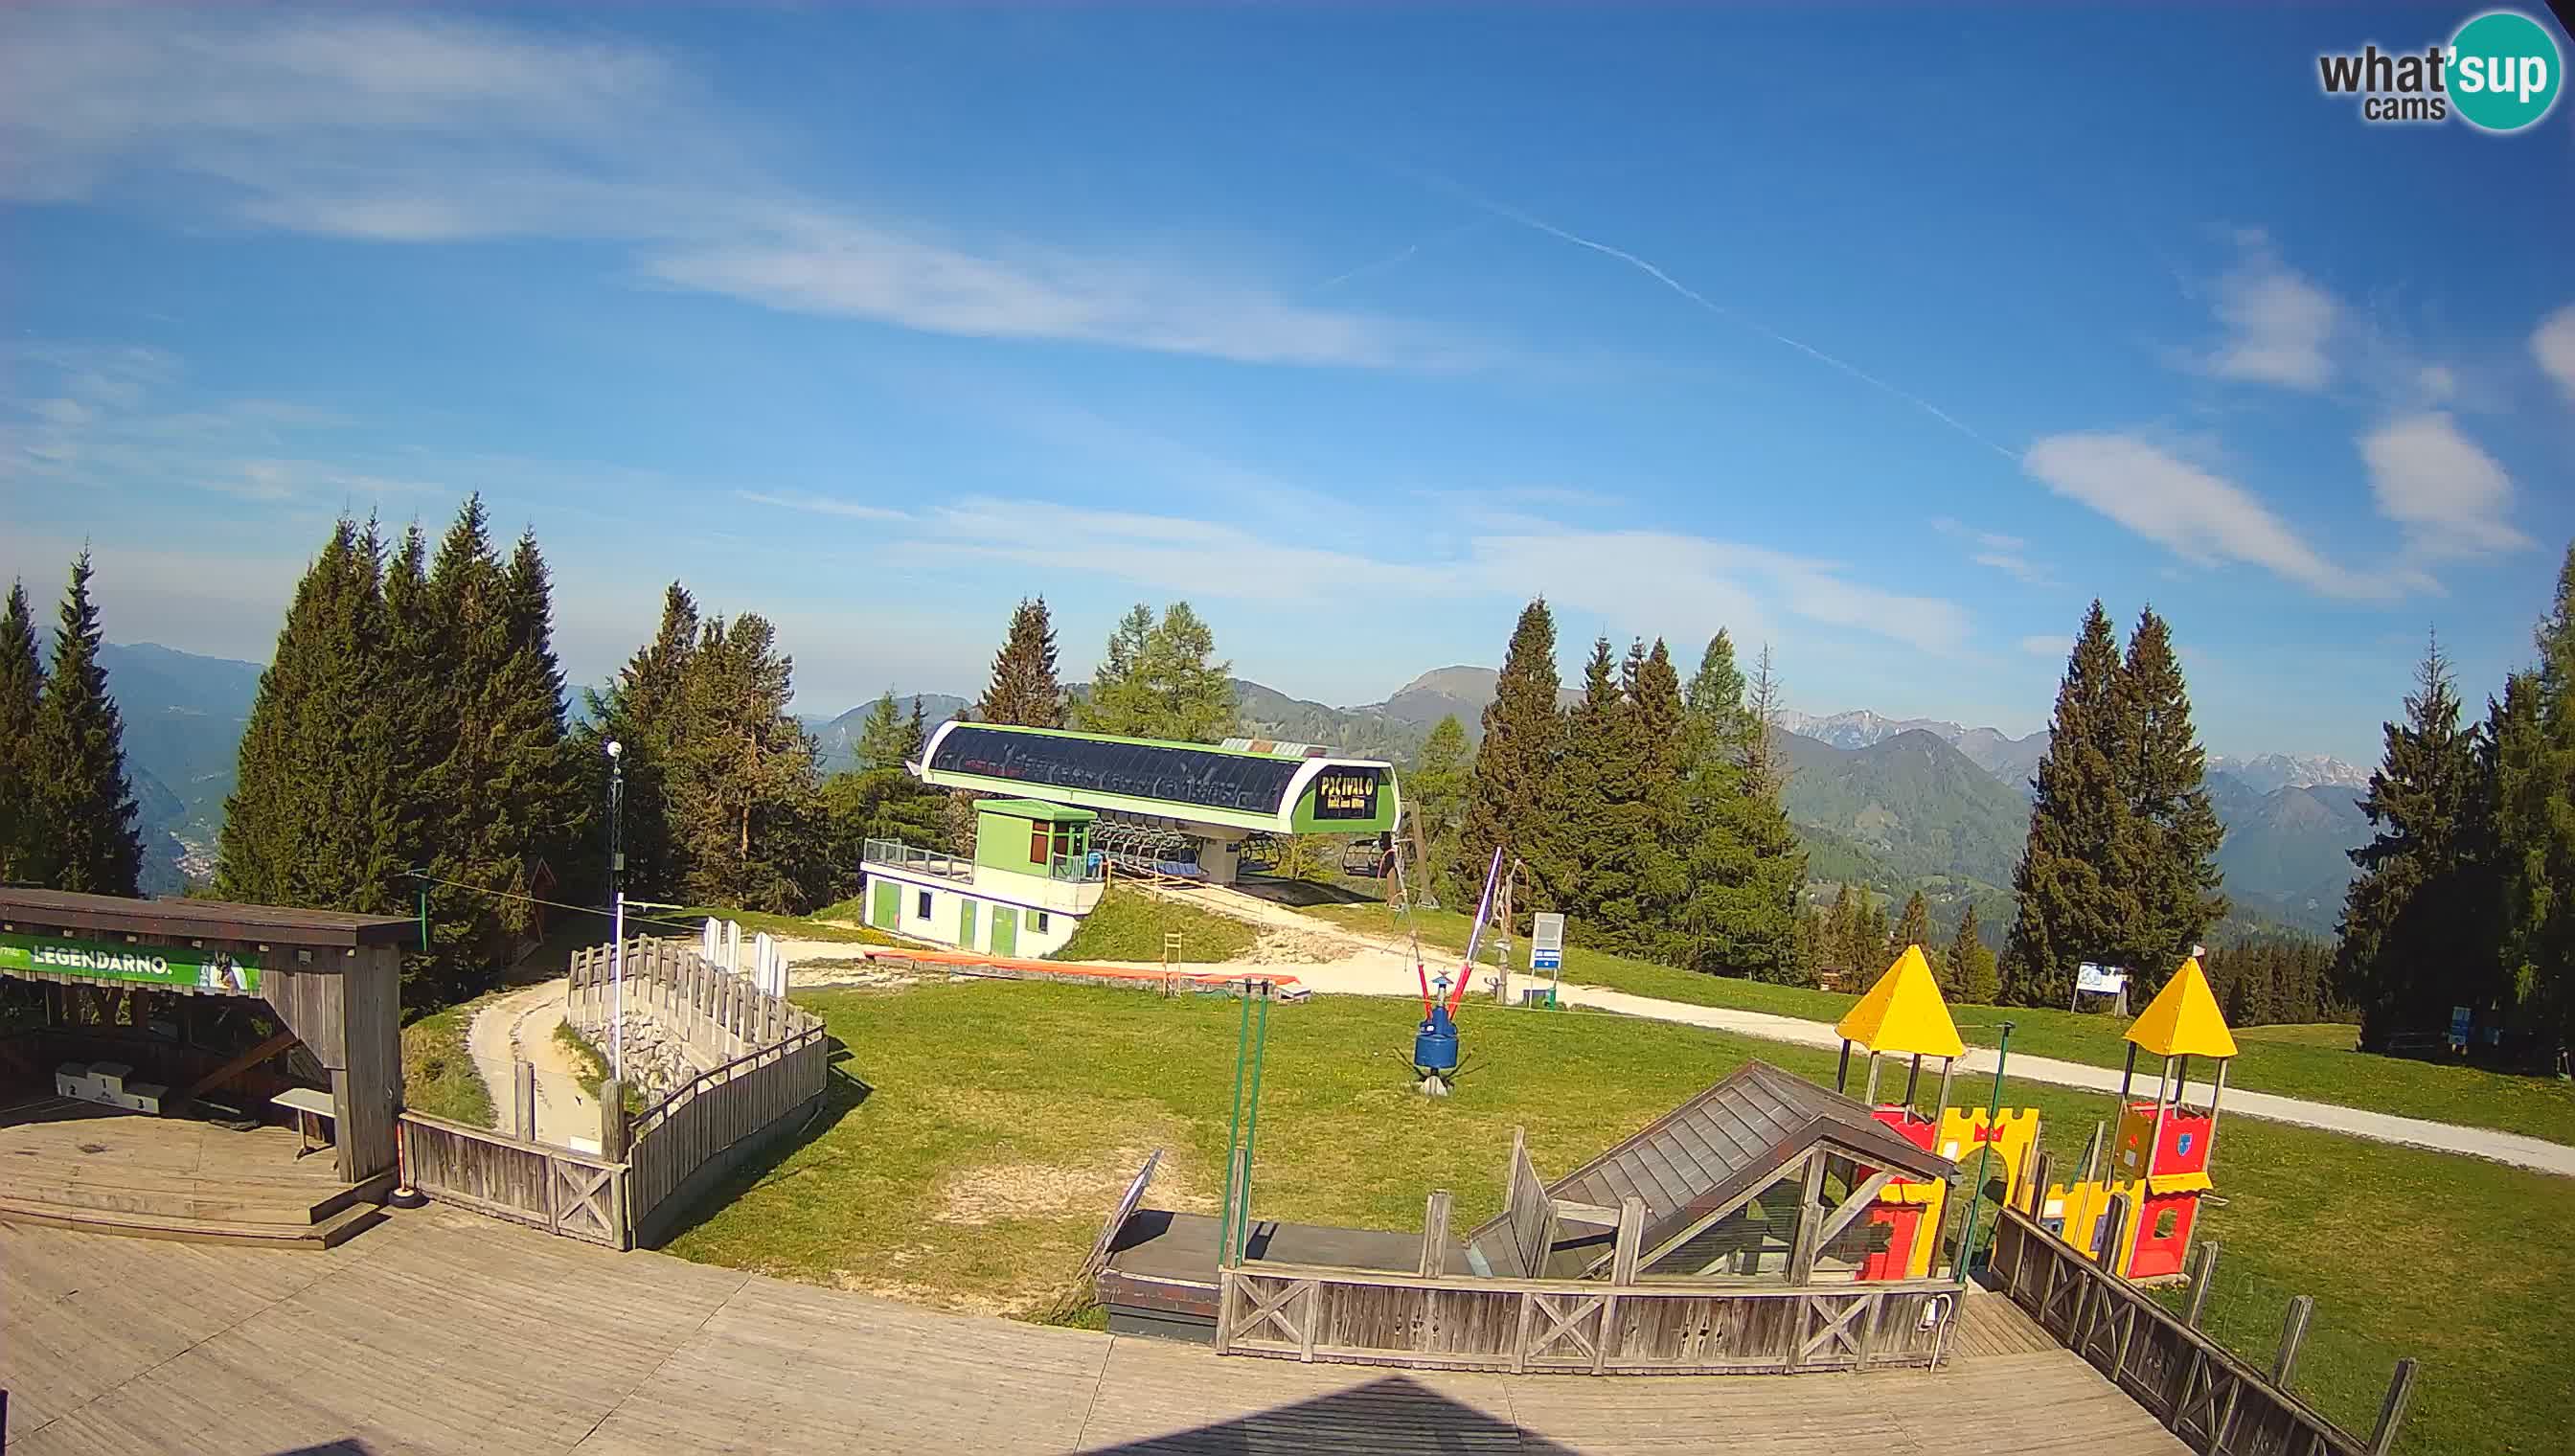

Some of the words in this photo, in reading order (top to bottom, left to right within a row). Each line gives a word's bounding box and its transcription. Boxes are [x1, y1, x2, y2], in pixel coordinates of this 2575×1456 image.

[33, 944, 173, 975] LEGENDARNO.
[101, 1078, 107, 1089] 1
[69, 1084, 77, 1096] 2
[137, 1098, 145, 1109] 3
